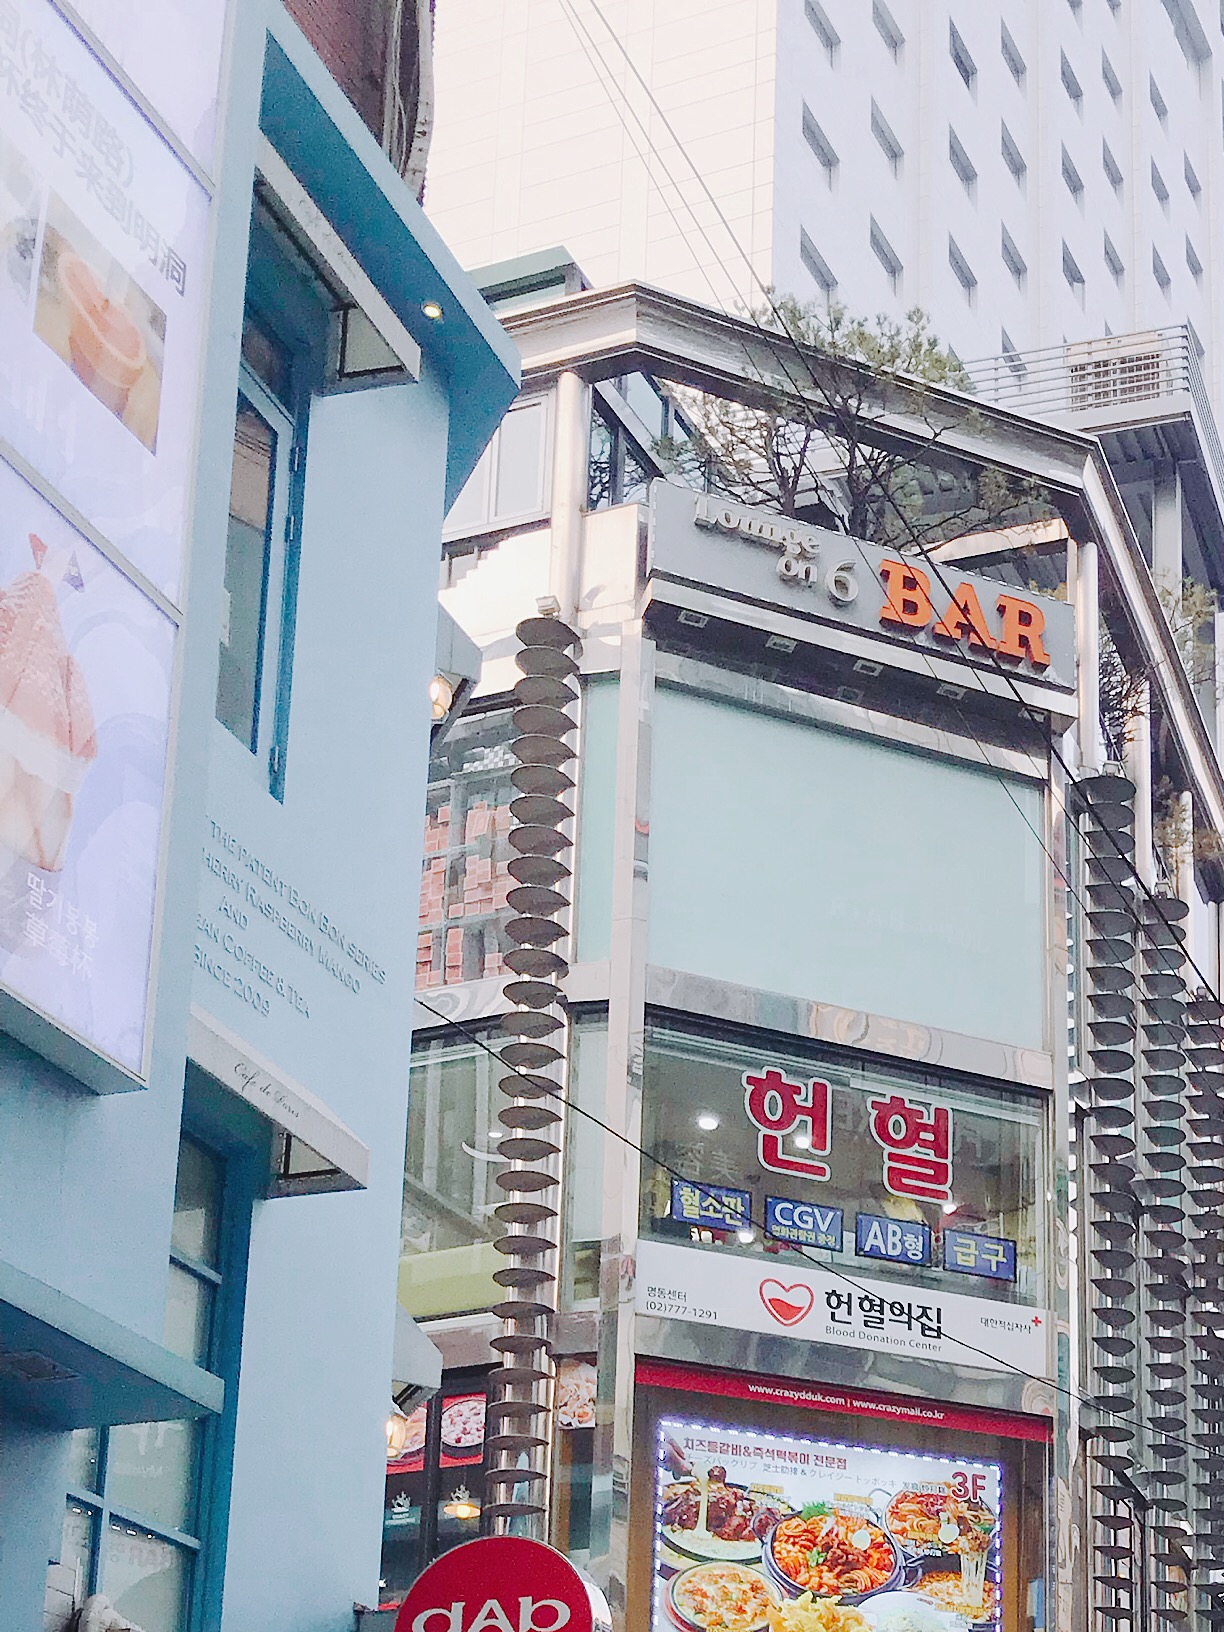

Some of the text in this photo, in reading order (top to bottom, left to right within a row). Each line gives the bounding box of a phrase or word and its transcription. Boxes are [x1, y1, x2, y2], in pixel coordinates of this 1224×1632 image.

[694, 494, 820, 556] Lounge
[776, 553, 859, 604] on 6
[879, 558, 1052, 670] BAR
[211, 819, 237, 855] THE
[238, 845, 287, 897] PATENT
[218, 895, 248, 930] AND
[288, 984, 310, 1019] TEA
[742, 1065, 955, 1206] 헌혈
[678, 1186, 746, 1227] 혈소판
[774, 1201, 836, 1231] CGV
[863, 1218, 925, 1262] AB형
[952, 1238, 1008, 1273] 급구
[645, 1300, 719, 1320] (02)777-1291
[646, 1285, 688, 1303] 명동센터
[825, 1288, 944, 1340] 헌혈의집
[825, 1325, 943, 1352] Blood Donation Center
[748, 1383, 845, 1406] www.crazydduk.com
[951, 1471, 987, 1502] 3F
